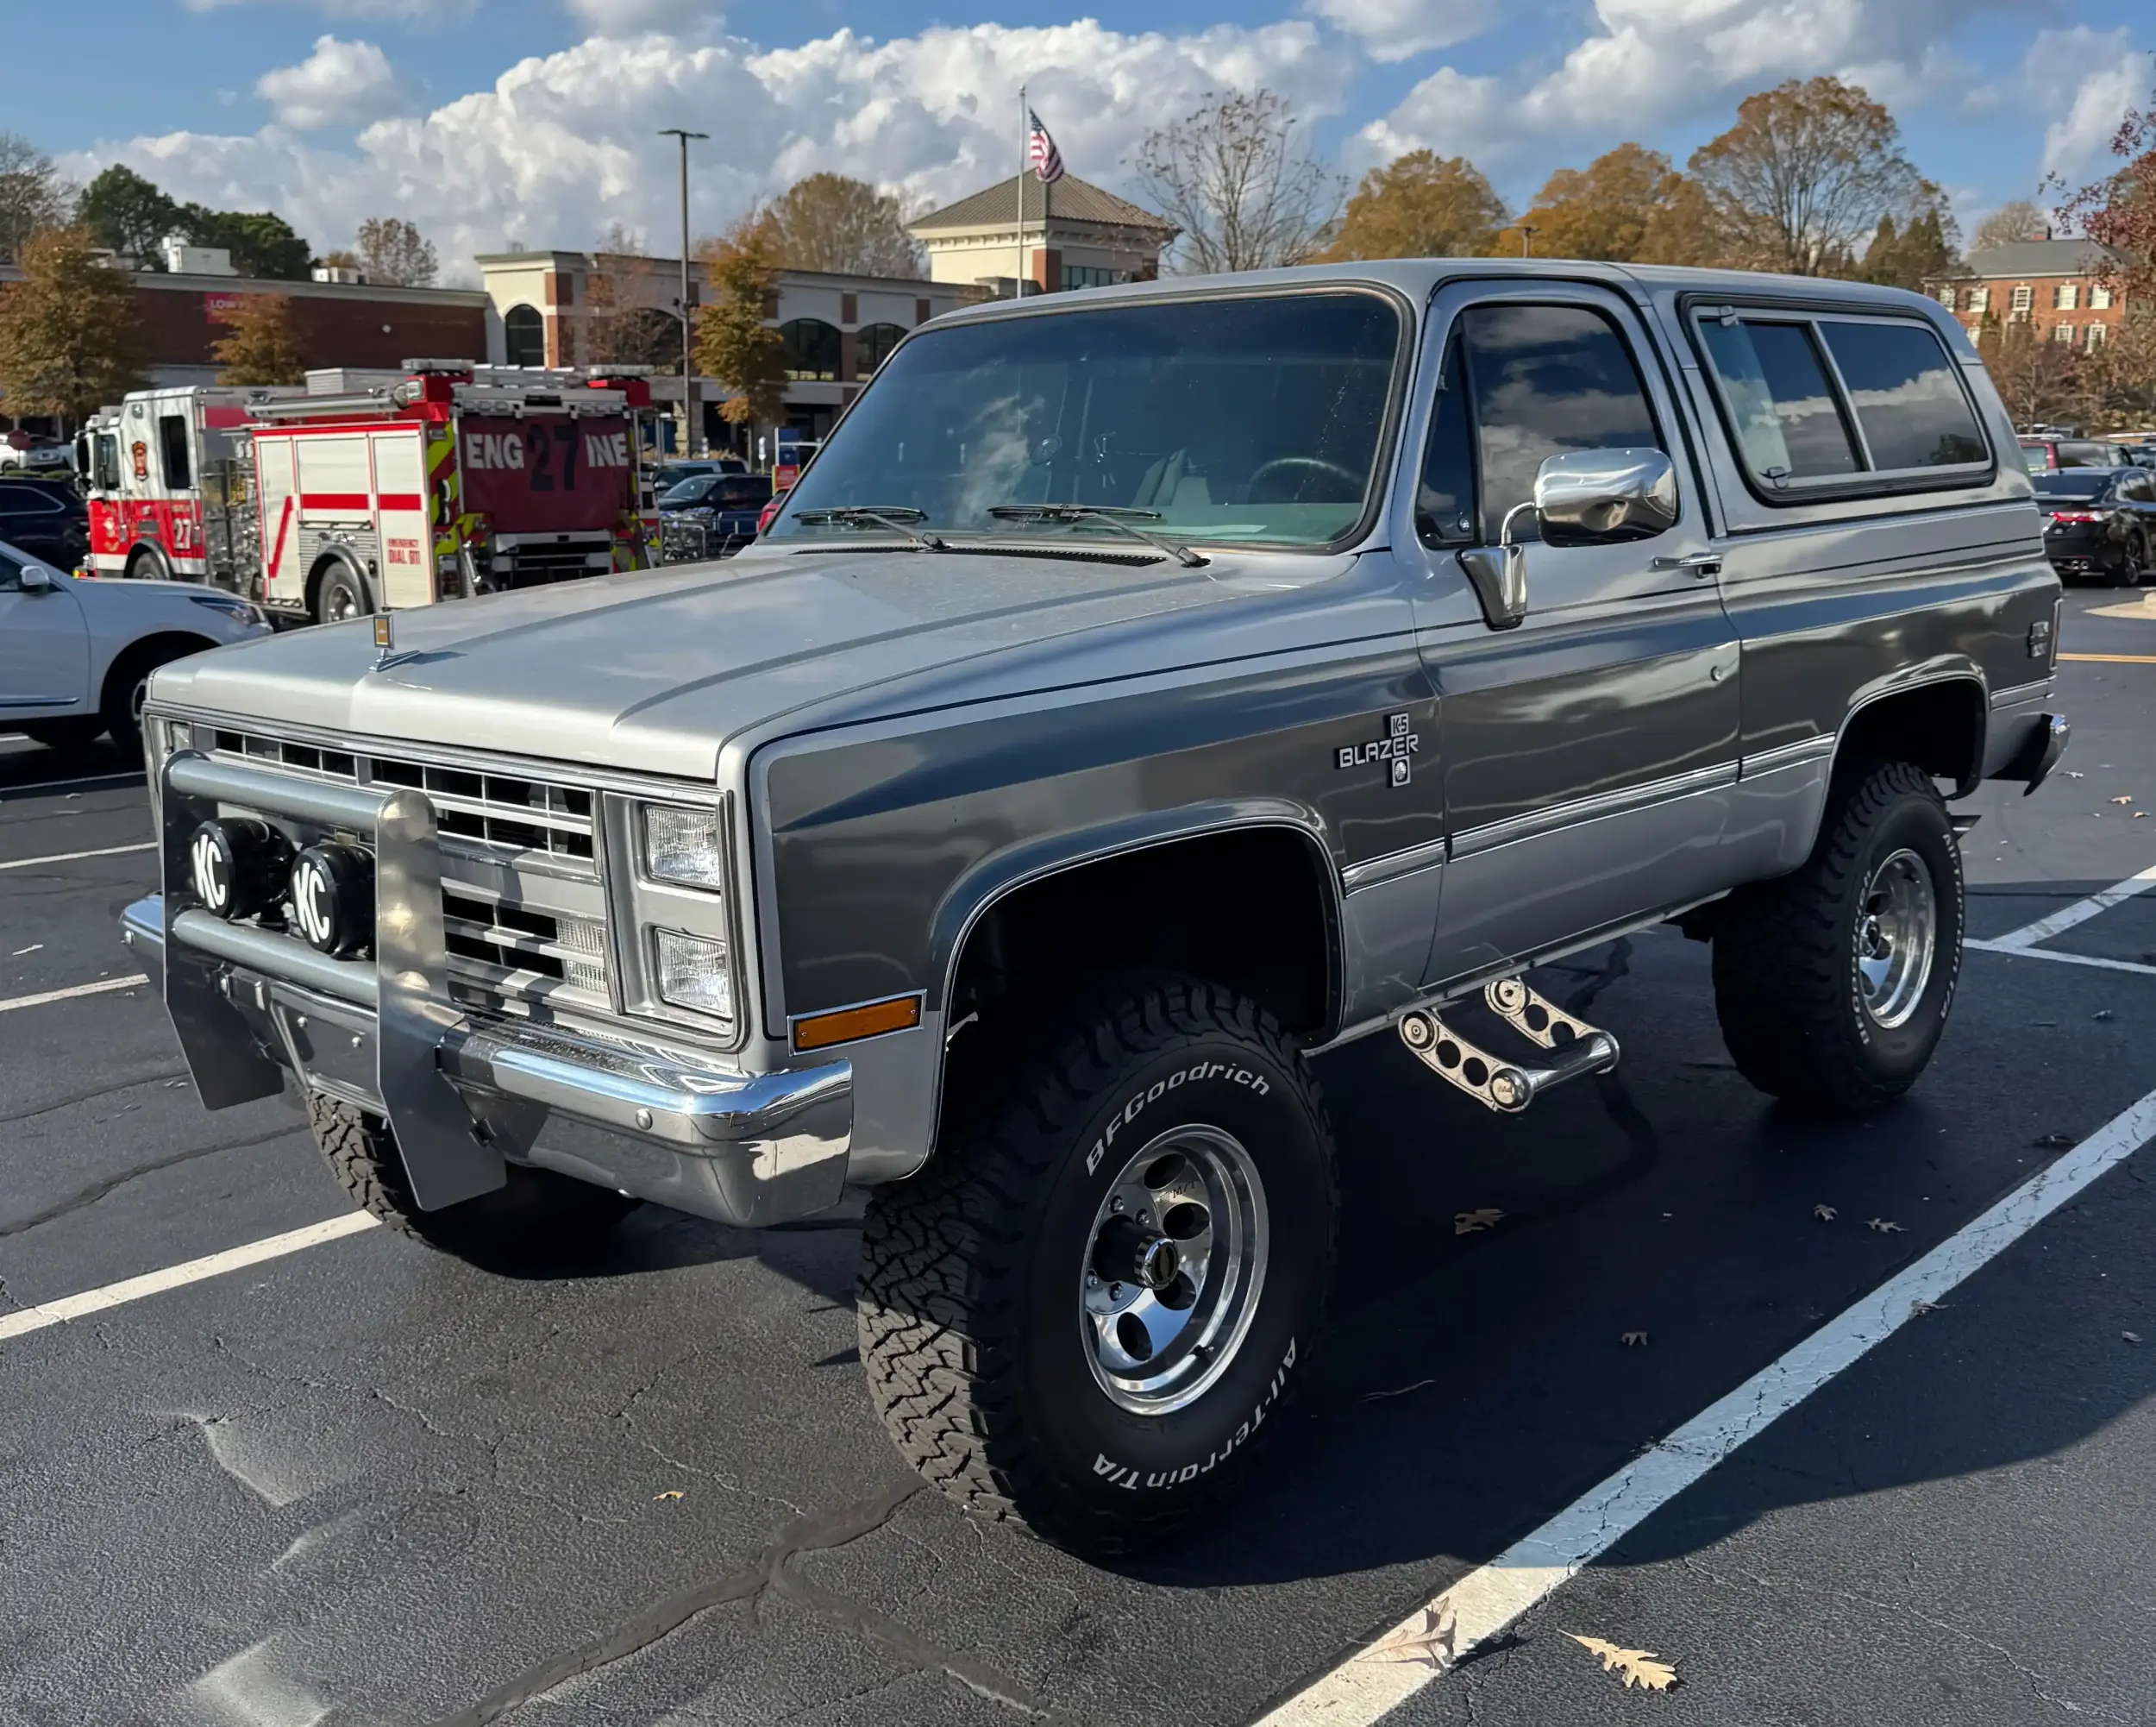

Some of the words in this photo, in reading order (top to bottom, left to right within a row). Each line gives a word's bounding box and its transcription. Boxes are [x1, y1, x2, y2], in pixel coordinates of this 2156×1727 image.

[466, 433, 524, 469] ENG
[526, 423, 579, 492] 27
[585, 432, 630, 468] INE
[174, 518, 191, 550] 27
[1339, 733, 1419, 768] BLAZER
[192, 833, 226, 910] KC
[292, 862, 330, 944] KC
[1086, 1062, 1270, 1177] BFGoodrich
[1146, 1336, 1296, 1490] All-Terrain
[1093, 1453, 1140, 1490] T/A
